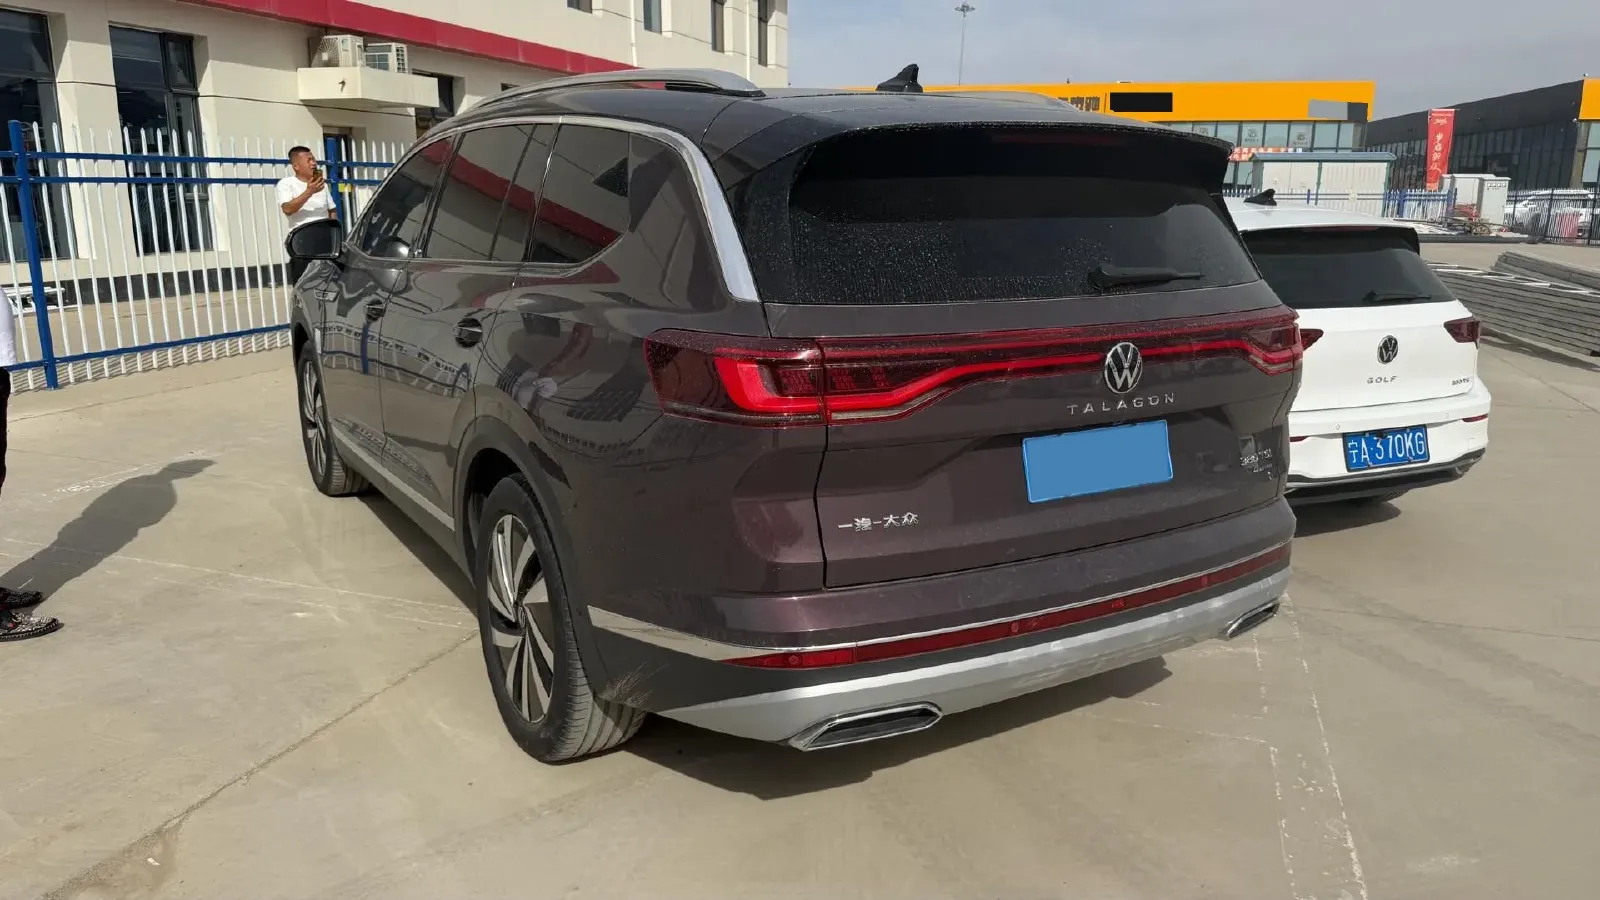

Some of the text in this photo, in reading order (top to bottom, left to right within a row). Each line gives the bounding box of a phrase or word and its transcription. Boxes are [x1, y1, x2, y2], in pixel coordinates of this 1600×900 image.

[1104, 342, 1143, 394] VW
[1366, 375, 1398, 385] GOLF
[1066, 392, 1175, 415] TALAGON
